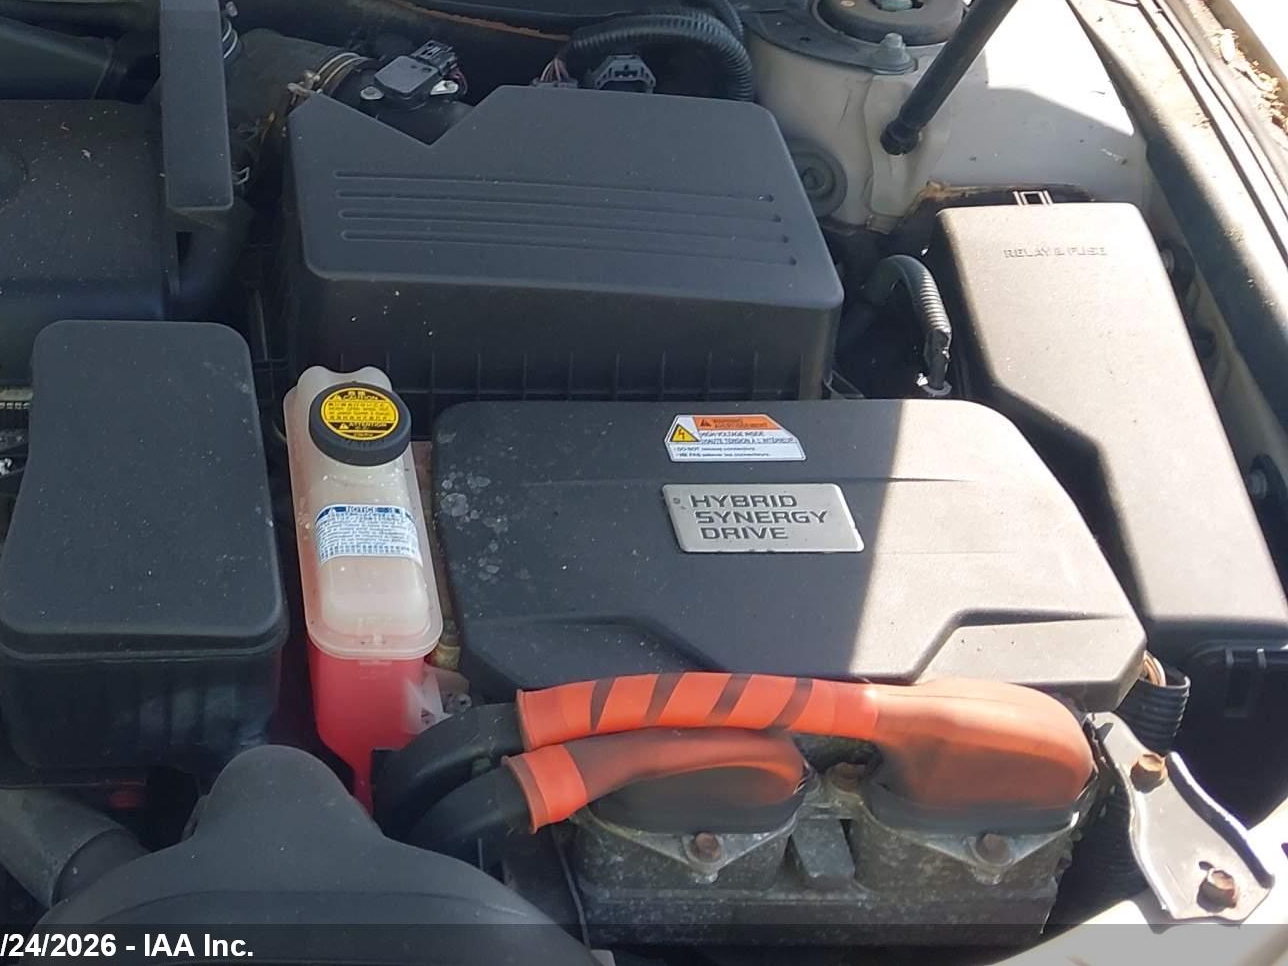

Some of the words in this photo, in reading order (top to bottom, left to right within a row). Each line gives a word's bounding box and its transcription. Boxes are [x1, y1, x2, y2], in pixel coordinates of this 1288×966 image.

[1003, 248, 1048, 258] RELAY
[1067, 246, 1108, 256] FUSE
[690, 495, 797, 508] HYBRID
[695, 511, 827, 524] SYNERGY
[700, 527, 788, 540] DRIVE
